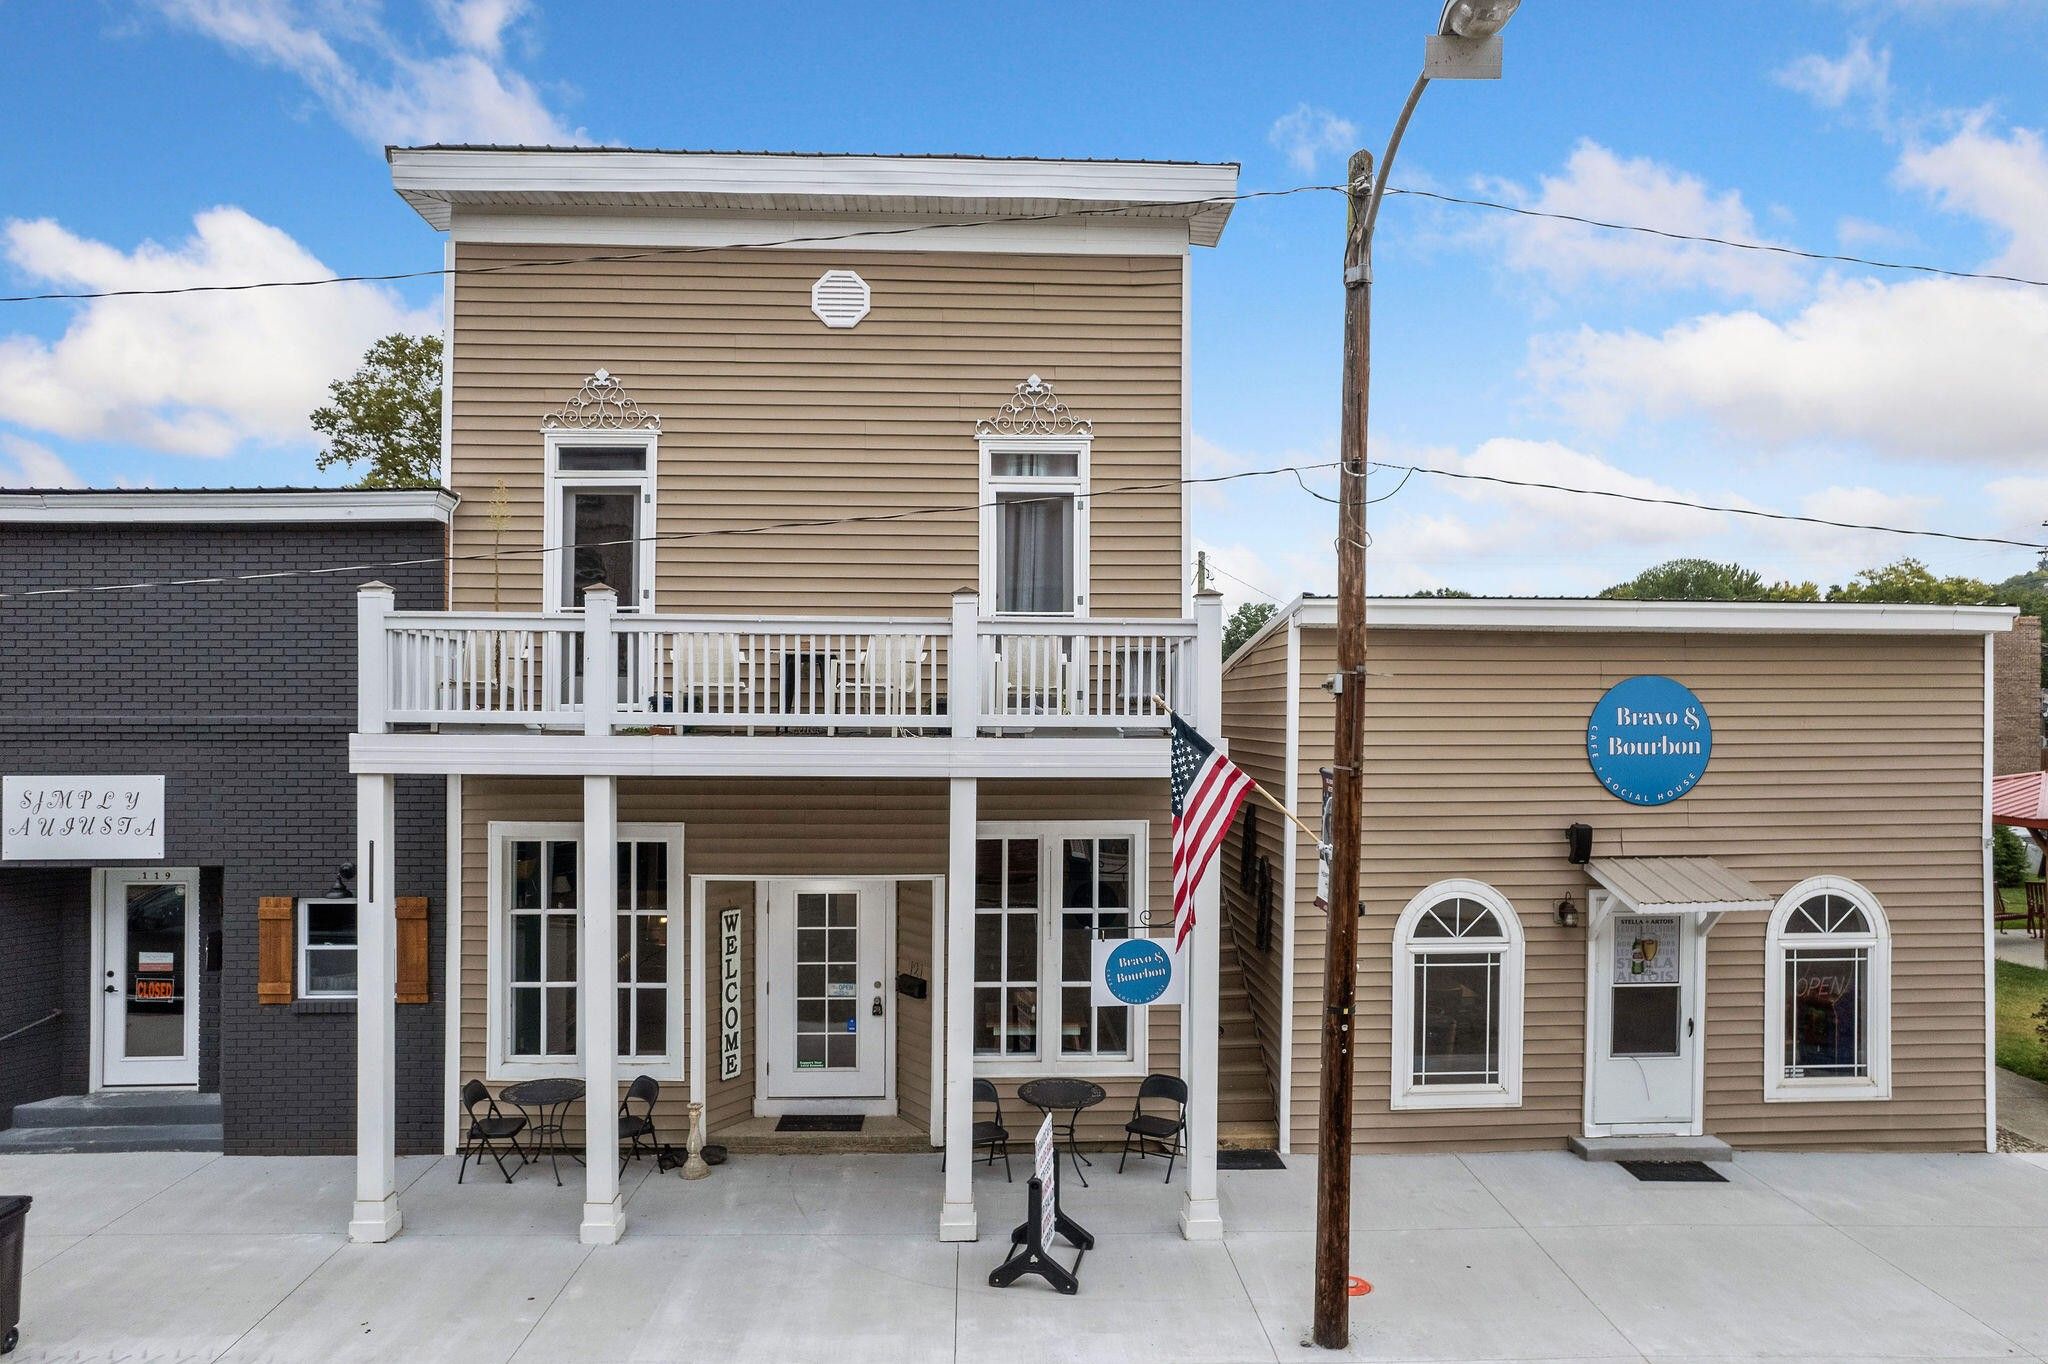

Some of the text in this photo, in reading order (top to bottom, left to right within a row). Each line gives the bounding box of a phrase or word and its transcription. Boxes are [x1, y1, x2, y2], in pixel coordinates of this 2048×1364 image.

[1616, 706, 1701, 730] Bravo &
[1608, 735, 1701, 756] Bourbon
[1590, 725, 1696, 802] CAFE SOCIAL HOUSE
[142, 871, 172, 880] 119
[1119, 951, 1164, 968] Bravo &
[1117, 968, 1166, 983] Bourbon
[1796, 975, 1845, 997] OPEN
[138, 977, 172, 999] CLOSED
[723, 913, 740, 1076] WELCOME
